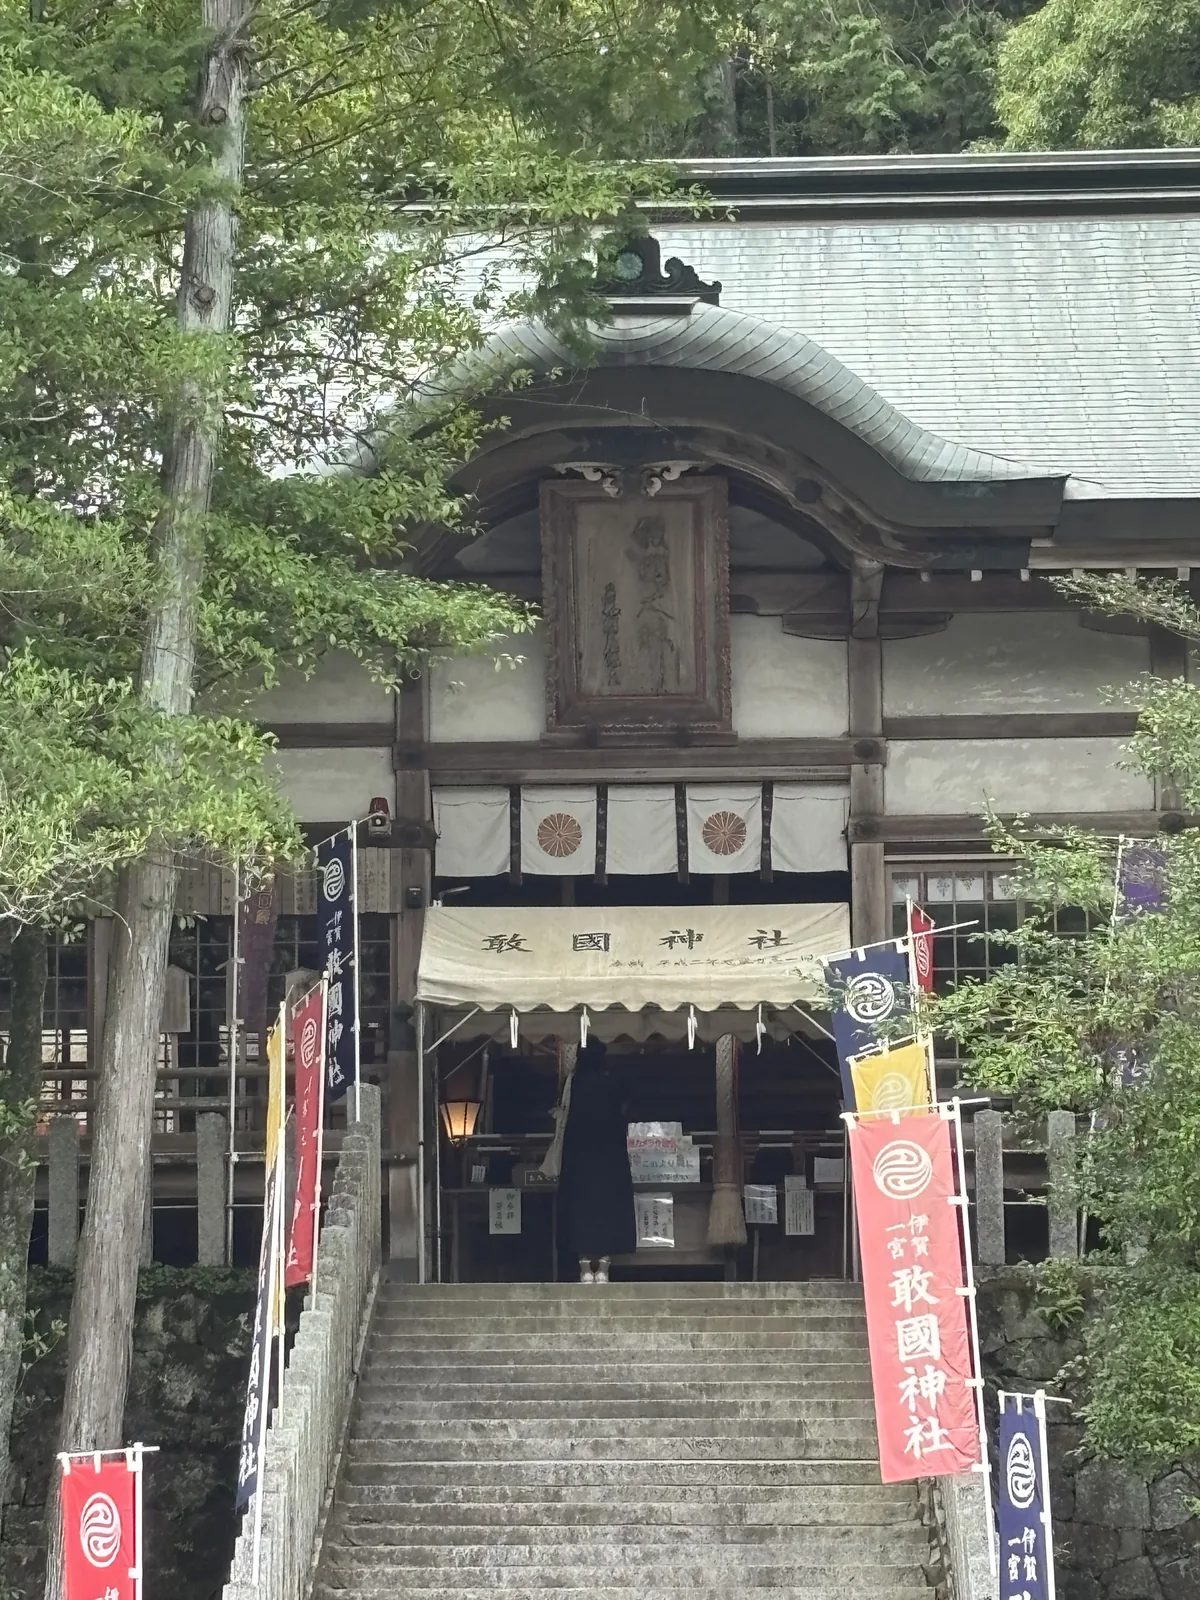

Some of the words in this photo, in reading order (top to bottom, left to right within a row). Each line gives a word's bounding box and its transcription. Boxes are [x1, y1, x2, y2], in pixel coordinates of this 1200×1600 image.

[482, 928, 794, 953] 敢國神社
[885, 1223, 908, 1260] 一宮
[907, 1213, 930, 1259] 伊賀
[888, 1265, 955, 1460] 敢國神社
[1007, 1537, 1021, 1583] 一宮
[1021, 1526, 1038, 1582] 伊賀
